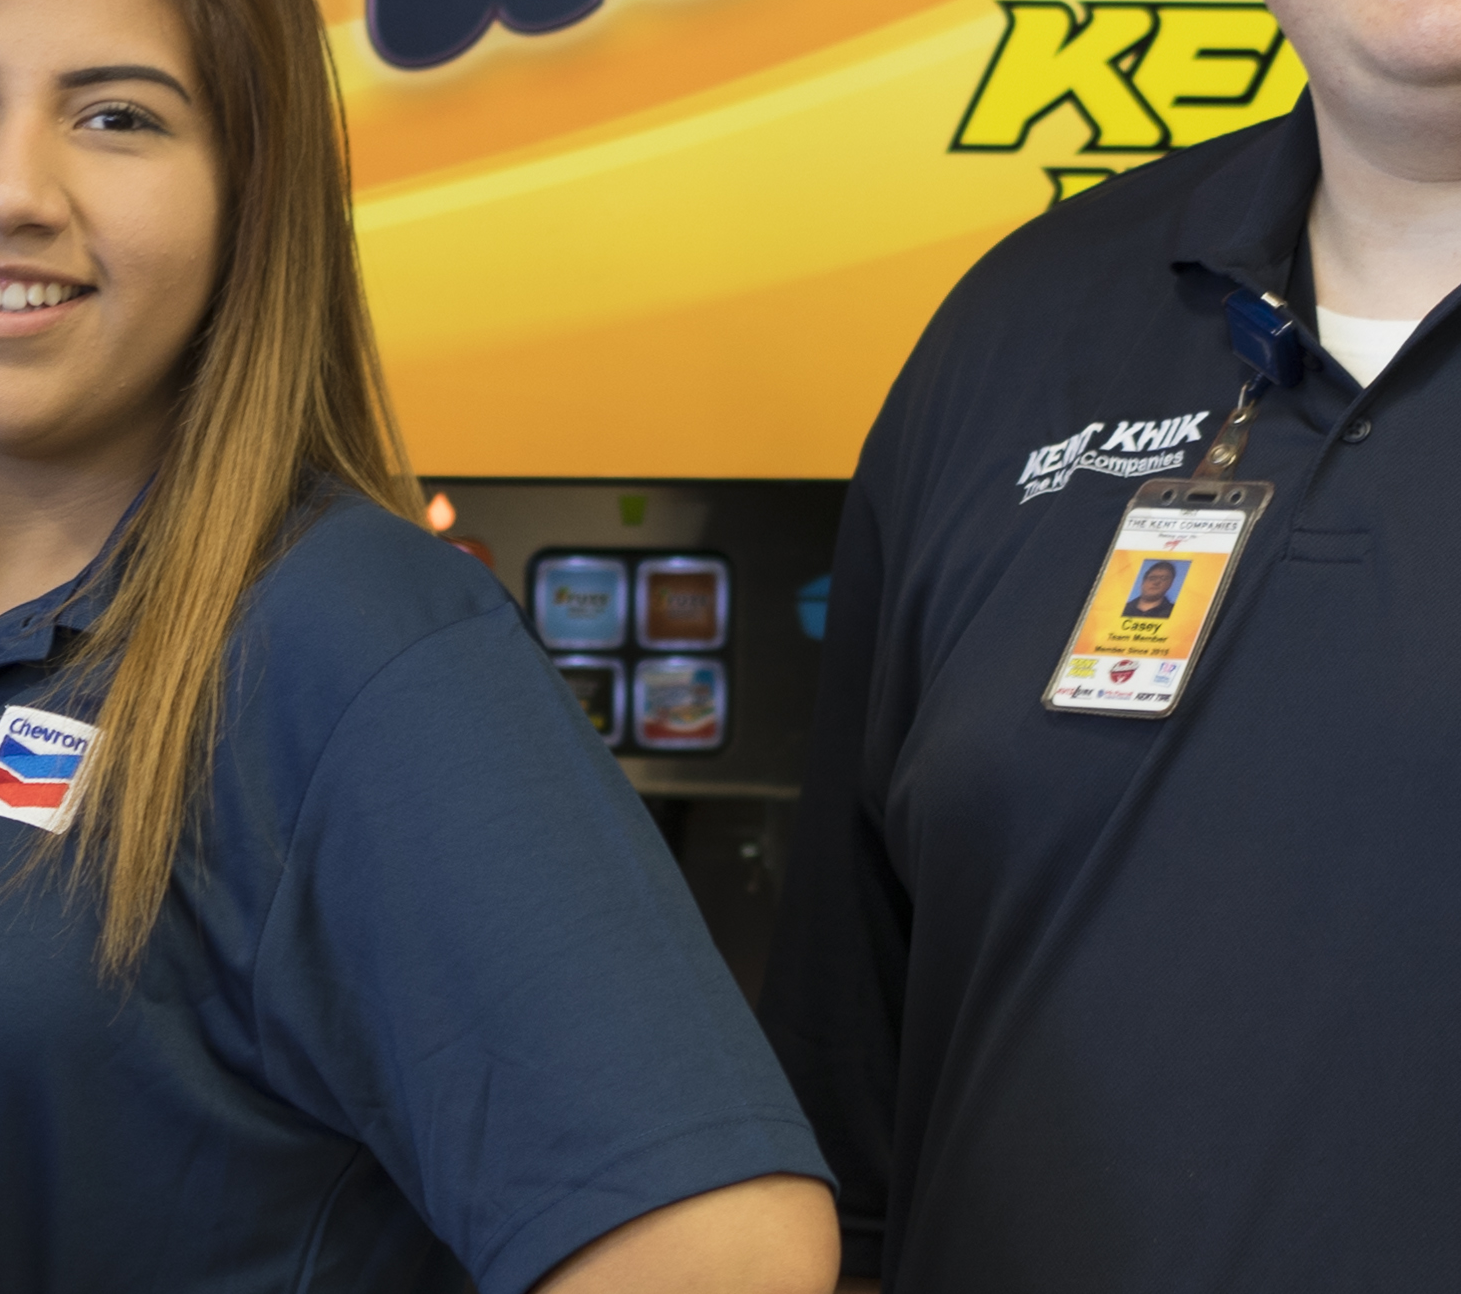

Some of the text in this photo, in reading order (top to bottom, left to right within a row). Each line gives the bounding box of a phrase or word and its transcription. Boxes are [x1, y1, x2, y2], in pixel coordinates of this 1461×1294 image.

[946, 0, 1308, 154] KE
[1015, 410, 1211, 486] KENT KWIK
[1079, 449, 1186, 478] Companies
[1128, 519, 1238, 531] THE KENT COMPANIES
[1121, 619, 1163, 636] Casey
[9, 717, 87, 753] Chevron
